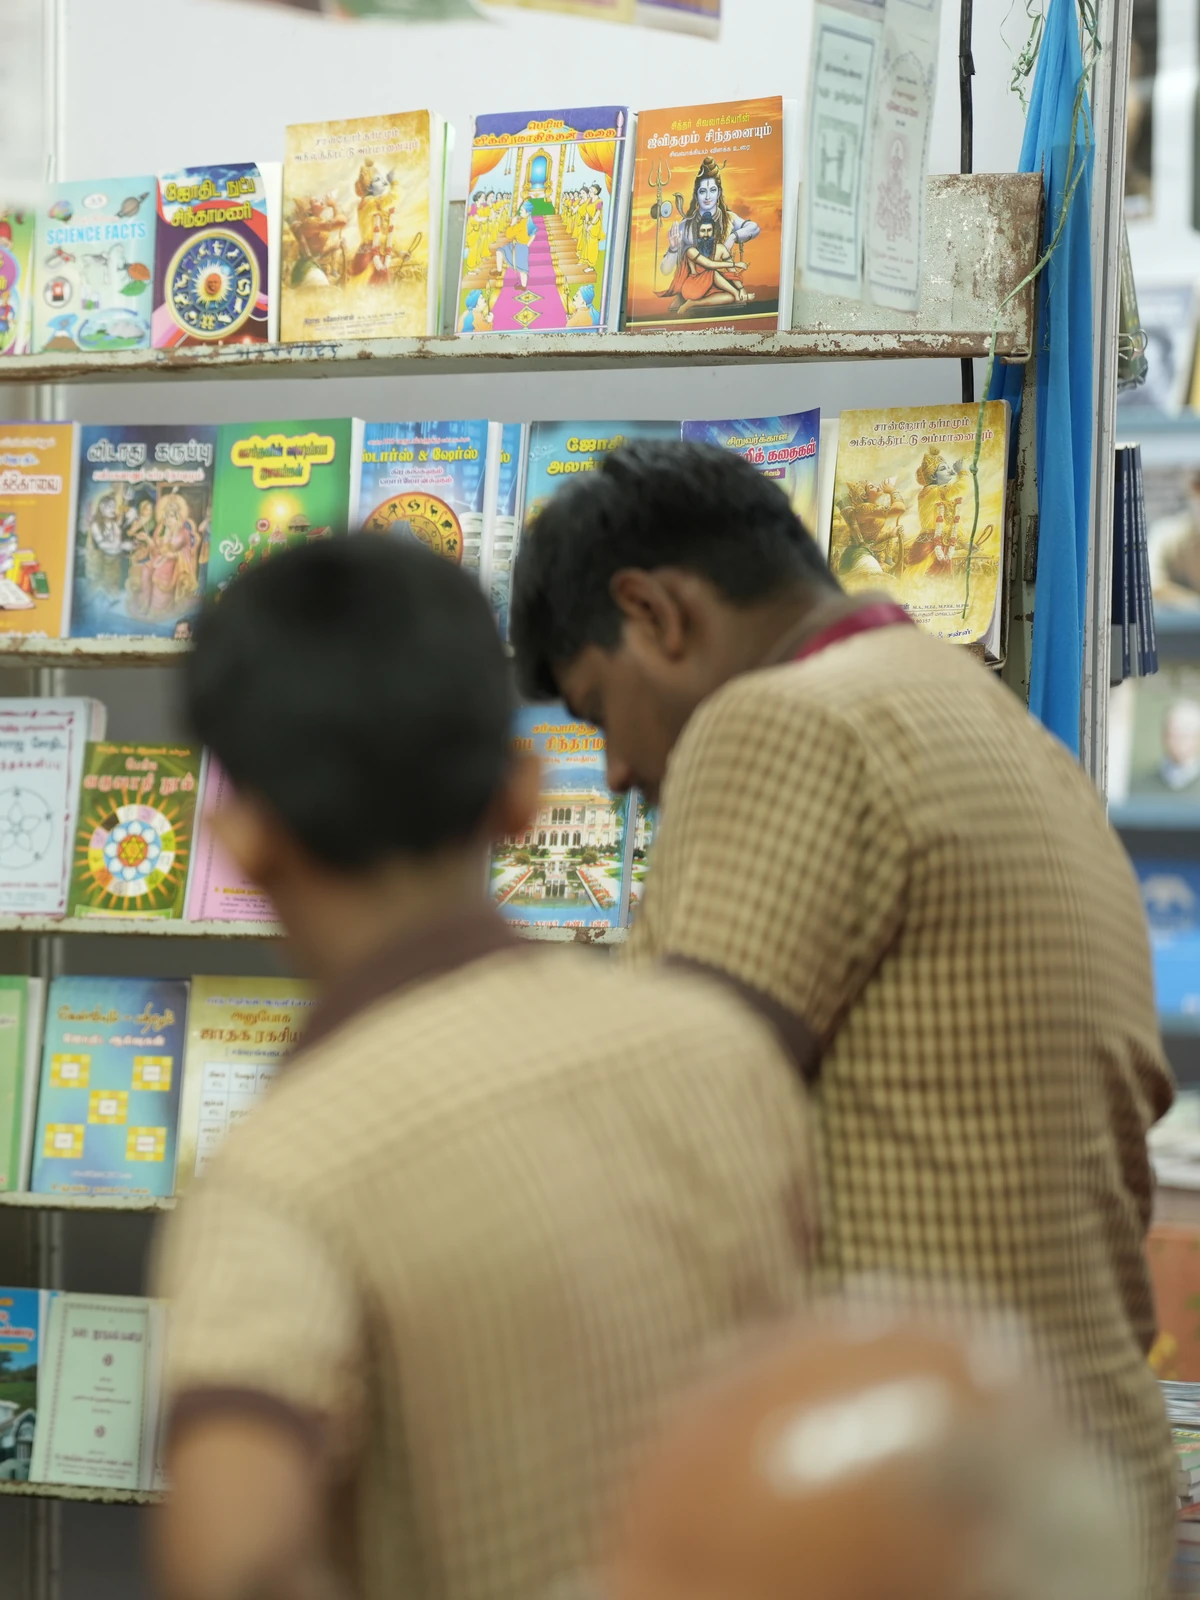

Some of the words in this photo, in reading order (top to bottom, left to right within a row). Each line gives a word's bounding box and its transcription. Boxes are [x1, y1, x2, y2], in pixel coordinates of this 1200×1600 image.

[527, 118, 565, 132] பெரிய
[584, 128, 617, 139] கதை
[647, 130, 700, 149] ஜீவிதமும்
[704, 122, 773, 144] சிந்தனையும்
[165, 179, 222, 203] ஜோதிட
[226, 176, 255, 198] நுட்ப
[170, 200, 252, 228] சிந்தாமணி
[47, 226, 101, 245] SCIENCE
[105, 222, 147, 241] FACTS
[873, 420, 927, 432] சான்றோர்
[928, 416, 971, 430] தர்மமும்
[727, 432, 789, 447] சிறுவர்க்கான
[849, 434, 919, 448] அகிலத்திரட்டு
[87, 438, 147, 467] விடாது
[155, 438, 213, 467] கருப்பு
[418, 451, 428, 462] &
[432, 445, 478, 463] ஷேர்ஸ்
[767, 437, 817, 463] கதைகள்
[545, 735, 606, 754] சிந்தாம
